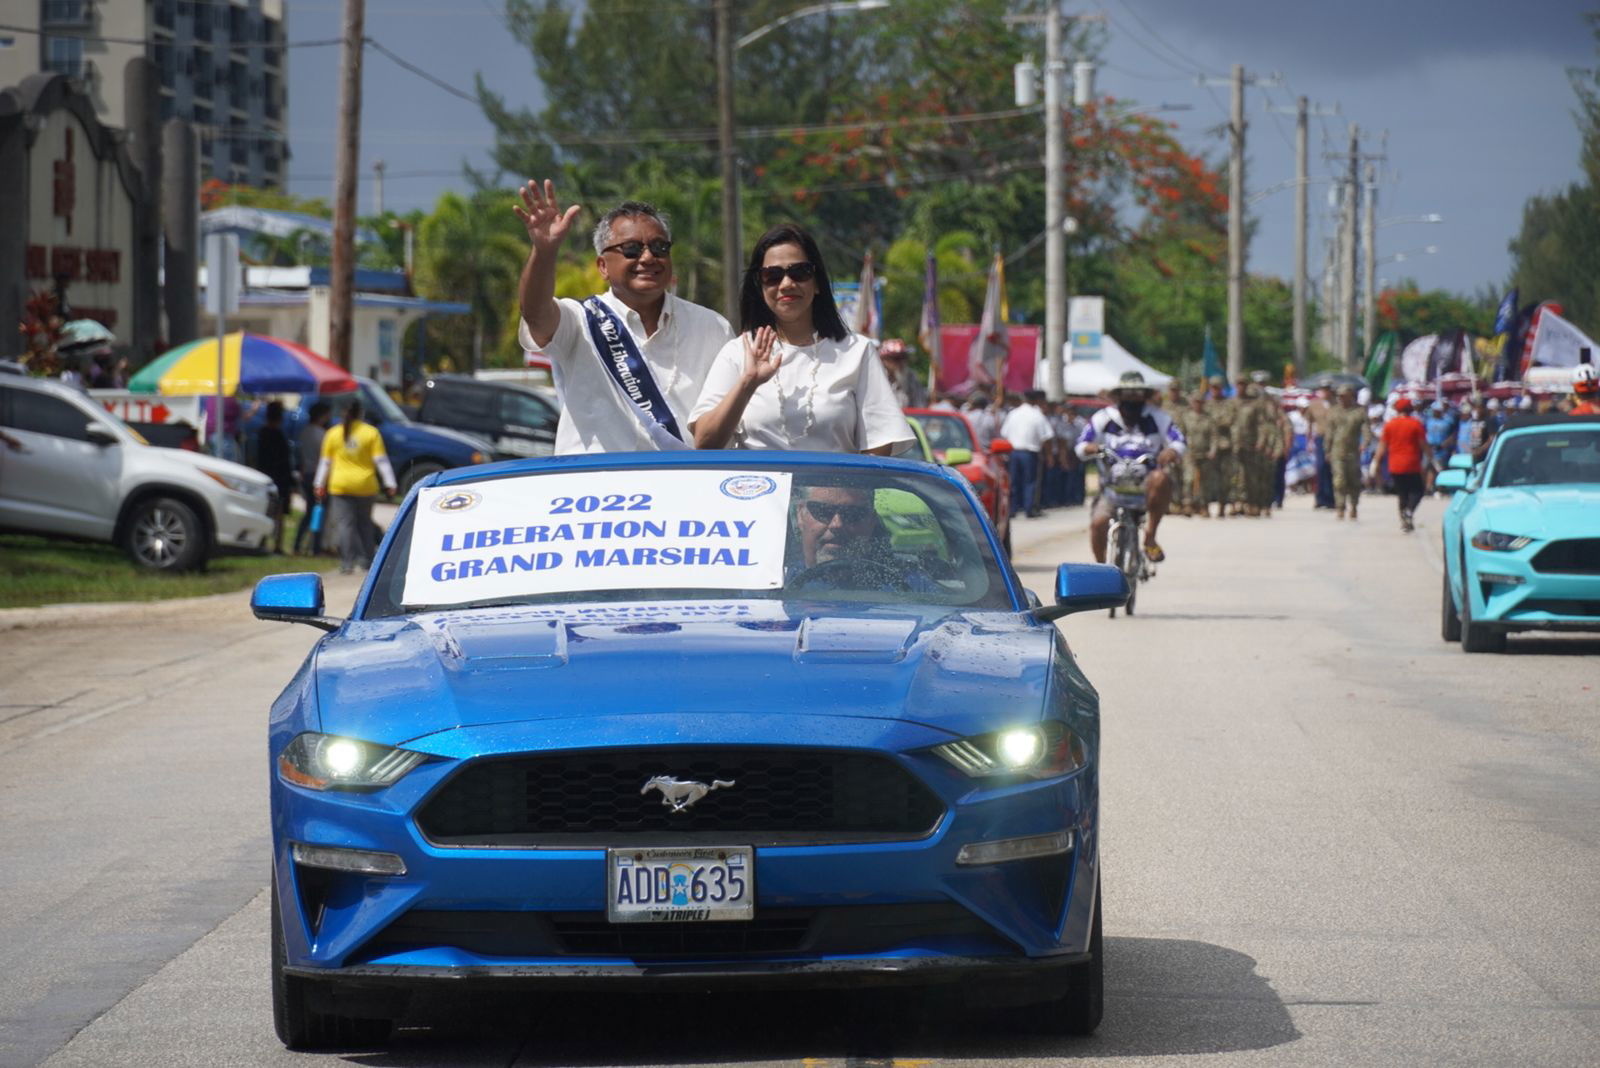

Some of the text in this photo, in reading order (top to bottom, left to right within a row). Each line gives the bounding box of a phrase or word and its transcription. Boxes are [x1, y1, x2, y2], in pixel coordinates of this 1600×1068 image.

[609, 342, 643, 404] Liberation
[549, 493, 653, 515] 2022
[441, 519, 756, 552] LIBERATION DAY
[431, 547, 759, 583] GRAND MARSHAL
[617, 865, 744, 904] ADD 635
